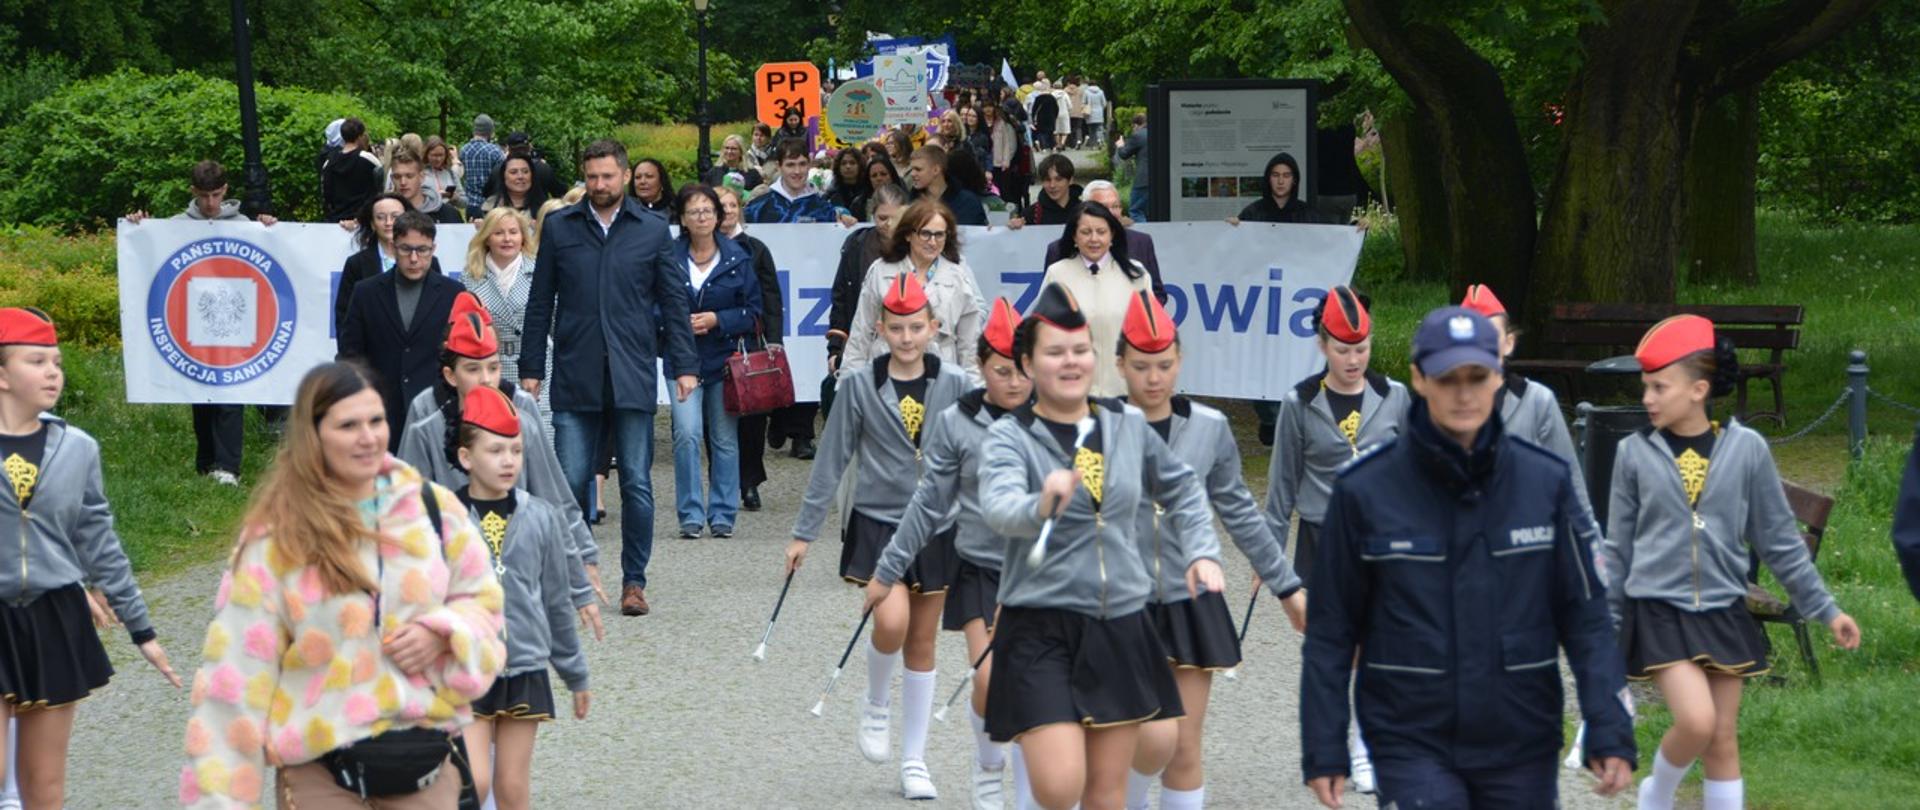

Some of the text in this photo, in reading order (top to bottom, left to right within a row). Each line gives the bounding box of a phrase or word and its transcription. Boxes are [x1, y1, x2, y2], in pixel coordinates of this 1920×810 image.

[767, 71, 808, 92] PP
[774, 97, 805, 119] 31
[171, 241, 273, 272] PAŃSTWOWA
[1000, 268, 1326, 338] Zowia
[150, 317, 293, 383] INSPEKCJA SANITARNA
[1510, 526, 1555, 545] POLICJ
